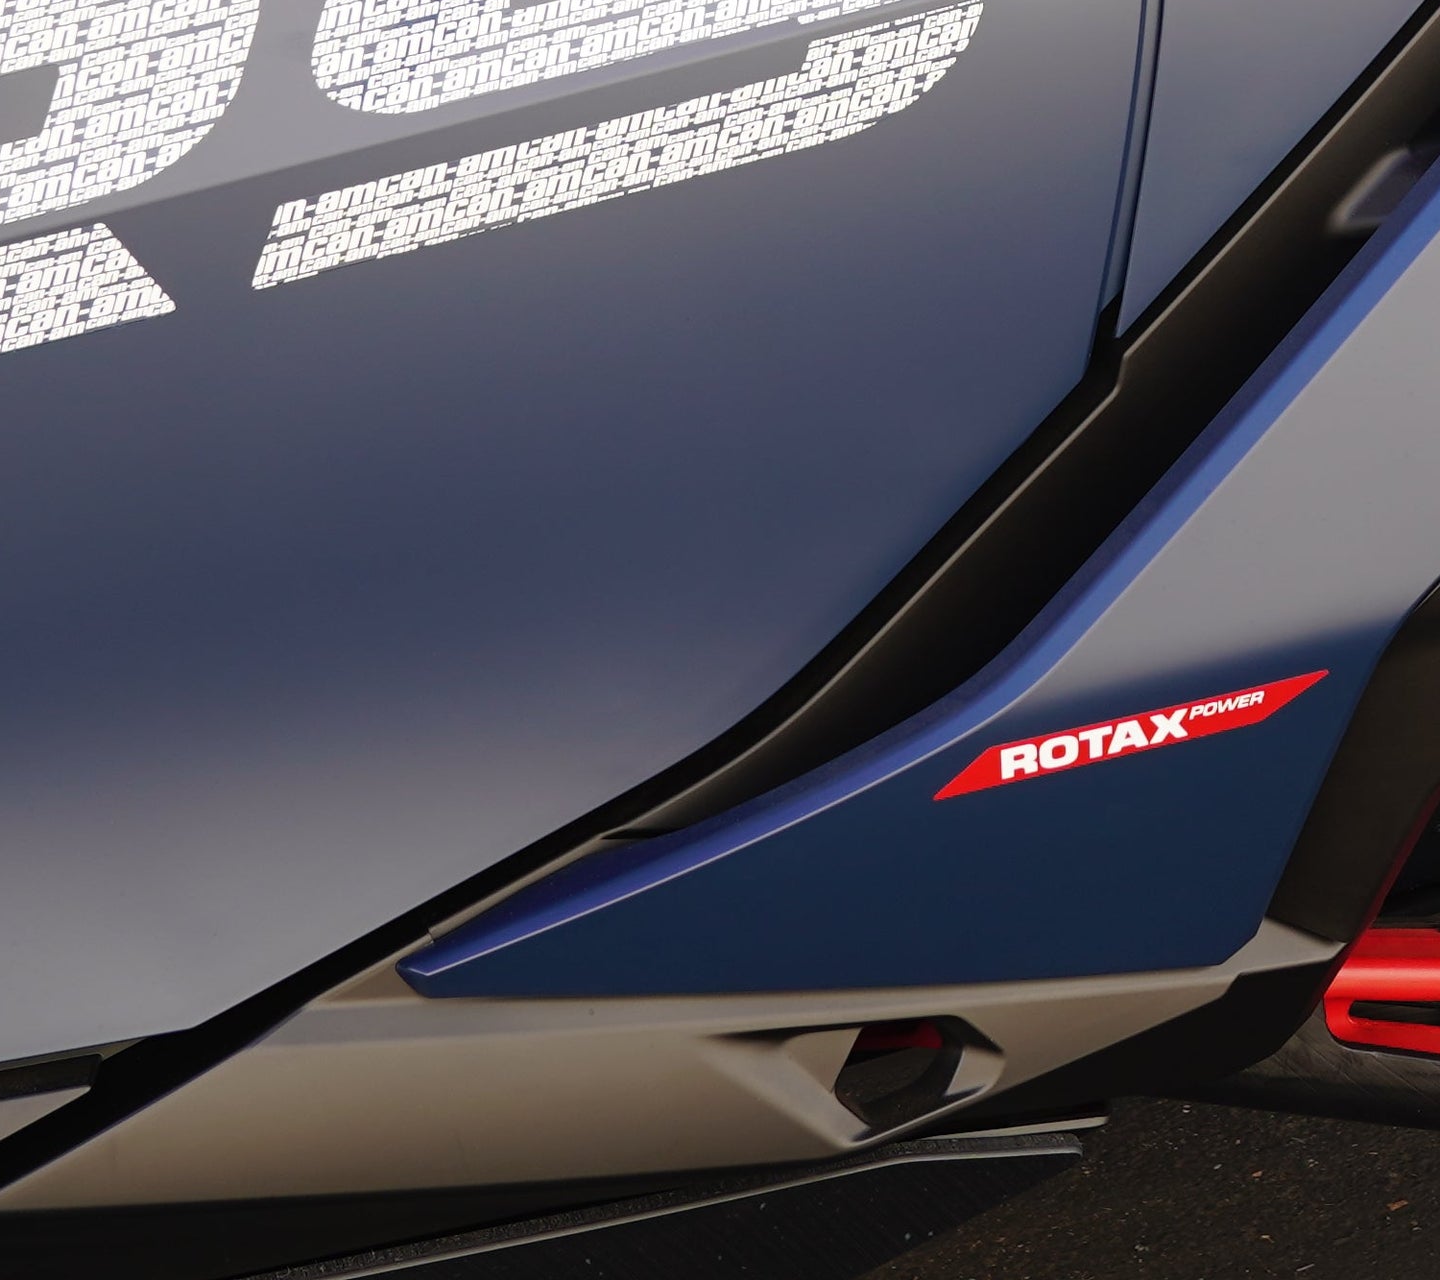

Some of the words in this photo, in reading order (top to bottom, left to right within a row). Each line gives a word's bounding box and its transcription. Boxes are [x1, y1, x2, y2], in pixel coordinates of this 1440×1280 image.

[2, 6, 149, 61] can-am
[73, 38, 220, 92] can-am
[361, 60, 499, 111] can-am
[500, 27, 638, 75] can-am
[717, 94, 852, 145] can-am
[444, 170, 583, 220] can-am
[582, 136, 715, 184] can-am
[303, 205, 446, 259] can-am
[4, 286, 151, 338] can-am
[1001, 708, 1189, 780] ROTAX
[1189, 690, 1265, 720] POWER
